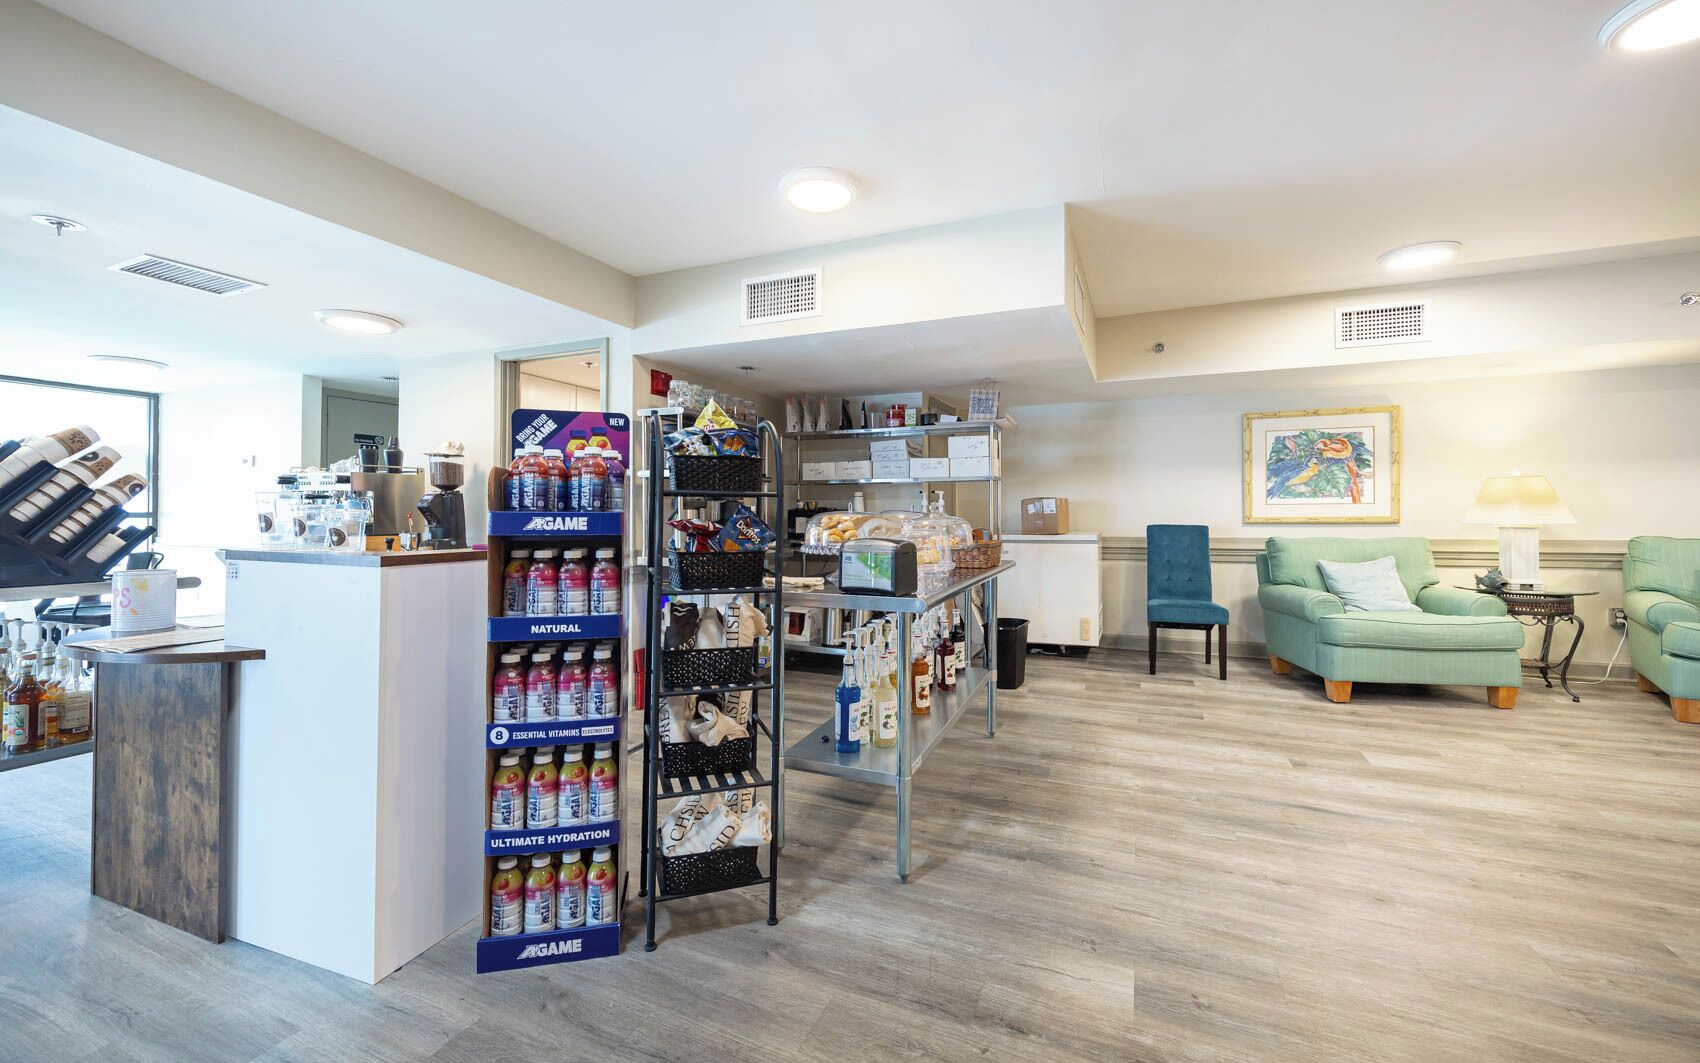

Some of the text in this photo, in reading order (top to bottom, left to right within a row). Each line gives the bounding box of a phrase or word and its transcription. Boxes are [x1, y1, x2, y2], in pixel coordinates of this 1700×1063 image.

[515, 413, 549, 443] BRING YOUR
[609, 417, 625, 427] NEW
[736, 519, 761, 544] Doritos
[530, 623, 582, 634] NATURAL
[495, 730, 503, 740] 8
[512, 730, 547, 740] ESSENTIAL
[548, 728, 580, 738] VITAMINS
[490, 829, 610, 848] ULTIMATE HYDRATION
